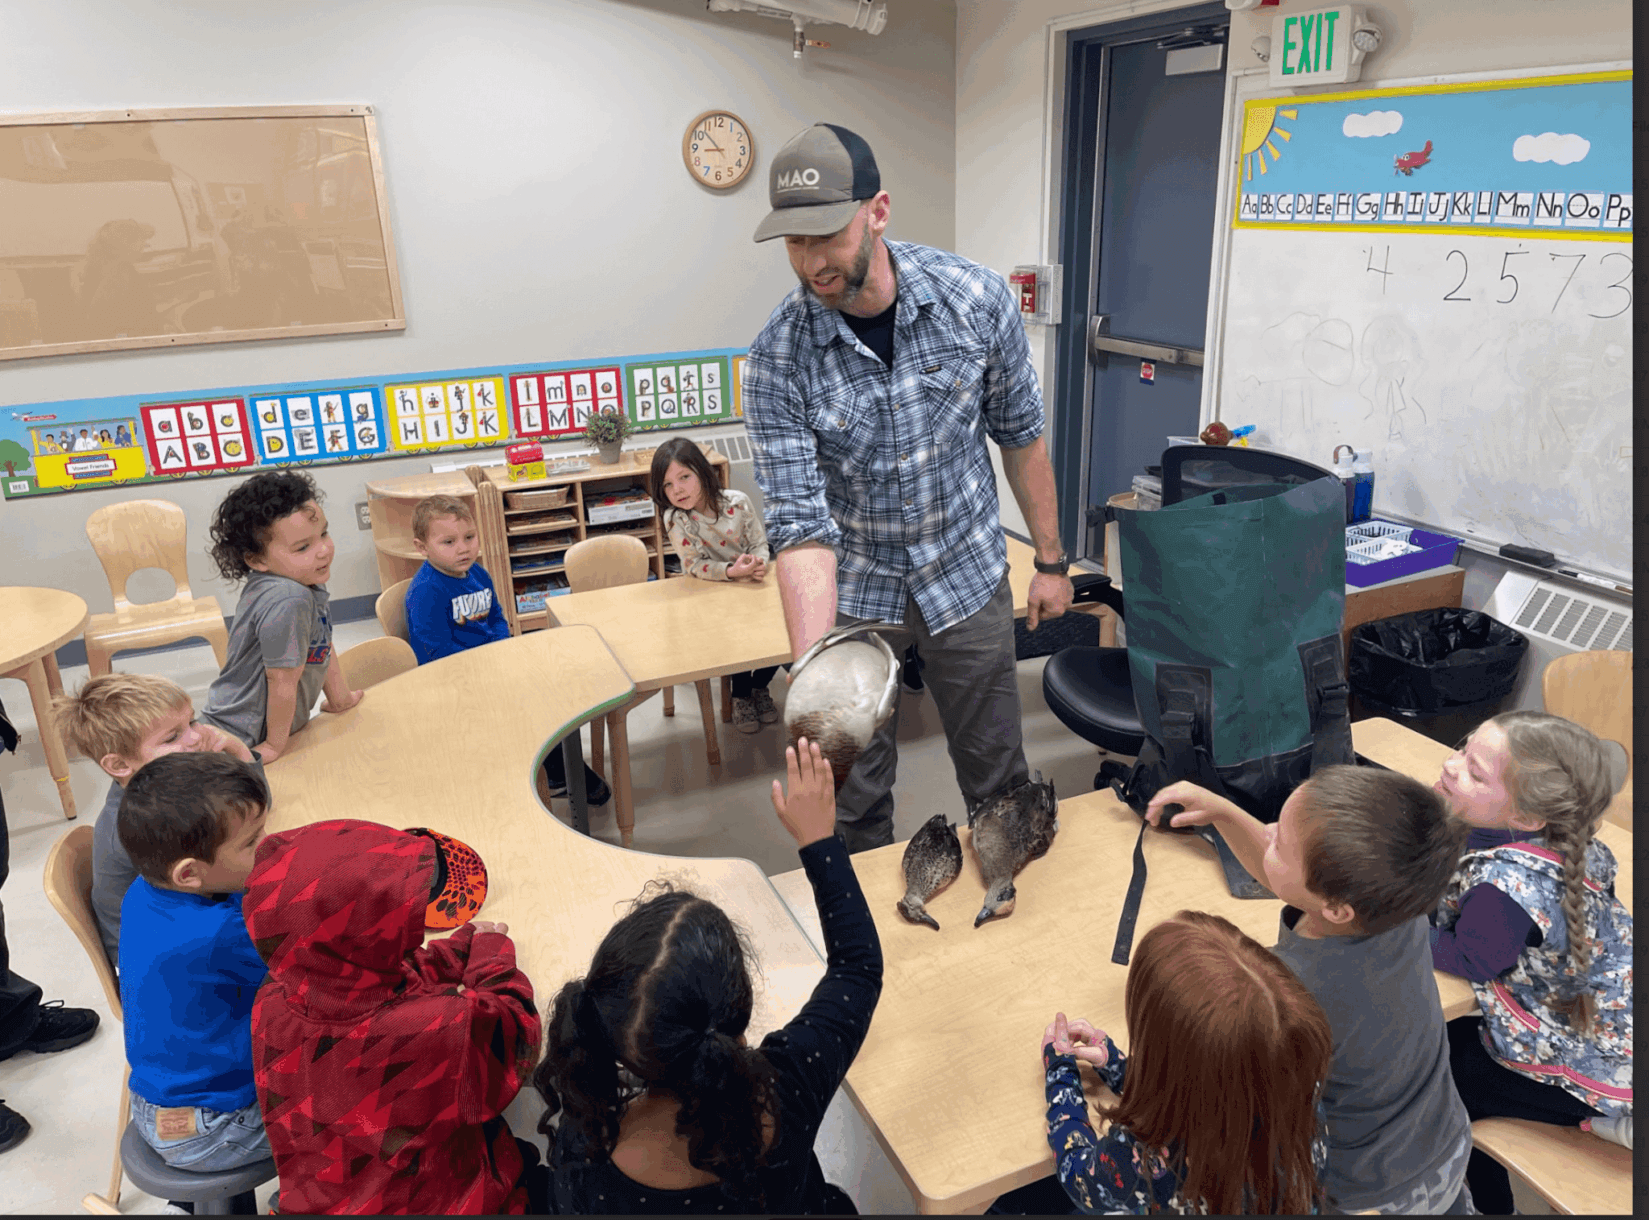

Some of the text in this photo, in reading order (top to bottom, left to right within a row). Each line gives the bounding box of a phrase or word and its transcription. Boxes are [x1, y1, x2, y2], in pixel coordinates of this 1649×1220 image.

[1282, 11, 1339, 76] EXIT
[704, 120, 711, 132] 11
[714, 116, 724, 128] 12
[730, 121, 733, 133] 1
[694, 130, 704, 141] 10
[736, 131, 743, 142] 2
[692, 143, 699, 154] 9
[739, 145, 746, 156] 3
[694, 156, 701, 167] 8
[703, 165, 711, 177] 7
[735, 158, 742, 168] 4
[715, 170, 722, 181] 6
[727, 166, 734, 177] 5
[777, 168, 820, 189] MAO
[1242, 191, 1631, 227] Aa Bb Cc Dd Ee Ff Gg Hh Ii Jj Kk Ll Mm Nn Oo Pp
[1366, 245, 1634, 319] 4 2 5 7 3
[547, 382, 564, 400] m
[576, 383, 587, 396] n
[601, 382, 613, 394] o
[639, 379, 650, 395] p
[660, 375, 674, 393] q
[707, 373, 716, 384] s
[400, 390, 414, 413] h
[478, 384, 496, 407] k
[641, 394, 718, 417] P Q R S
[158, 420, 173, 433] a
[187, 411, 204, 431] b
[263, 402, 278, 424] d
[294, 409, 307, 421] e
[356, 403, 370, 424] g
[525, 407, 540, 428] L
[549, 407, 568, 428] M
[576, 406, 591, 423] N
[402, 412, 499, 441] H I J K
[266, 426, 376, 454] D E F G
[163, 440, 243, 464] A B C
